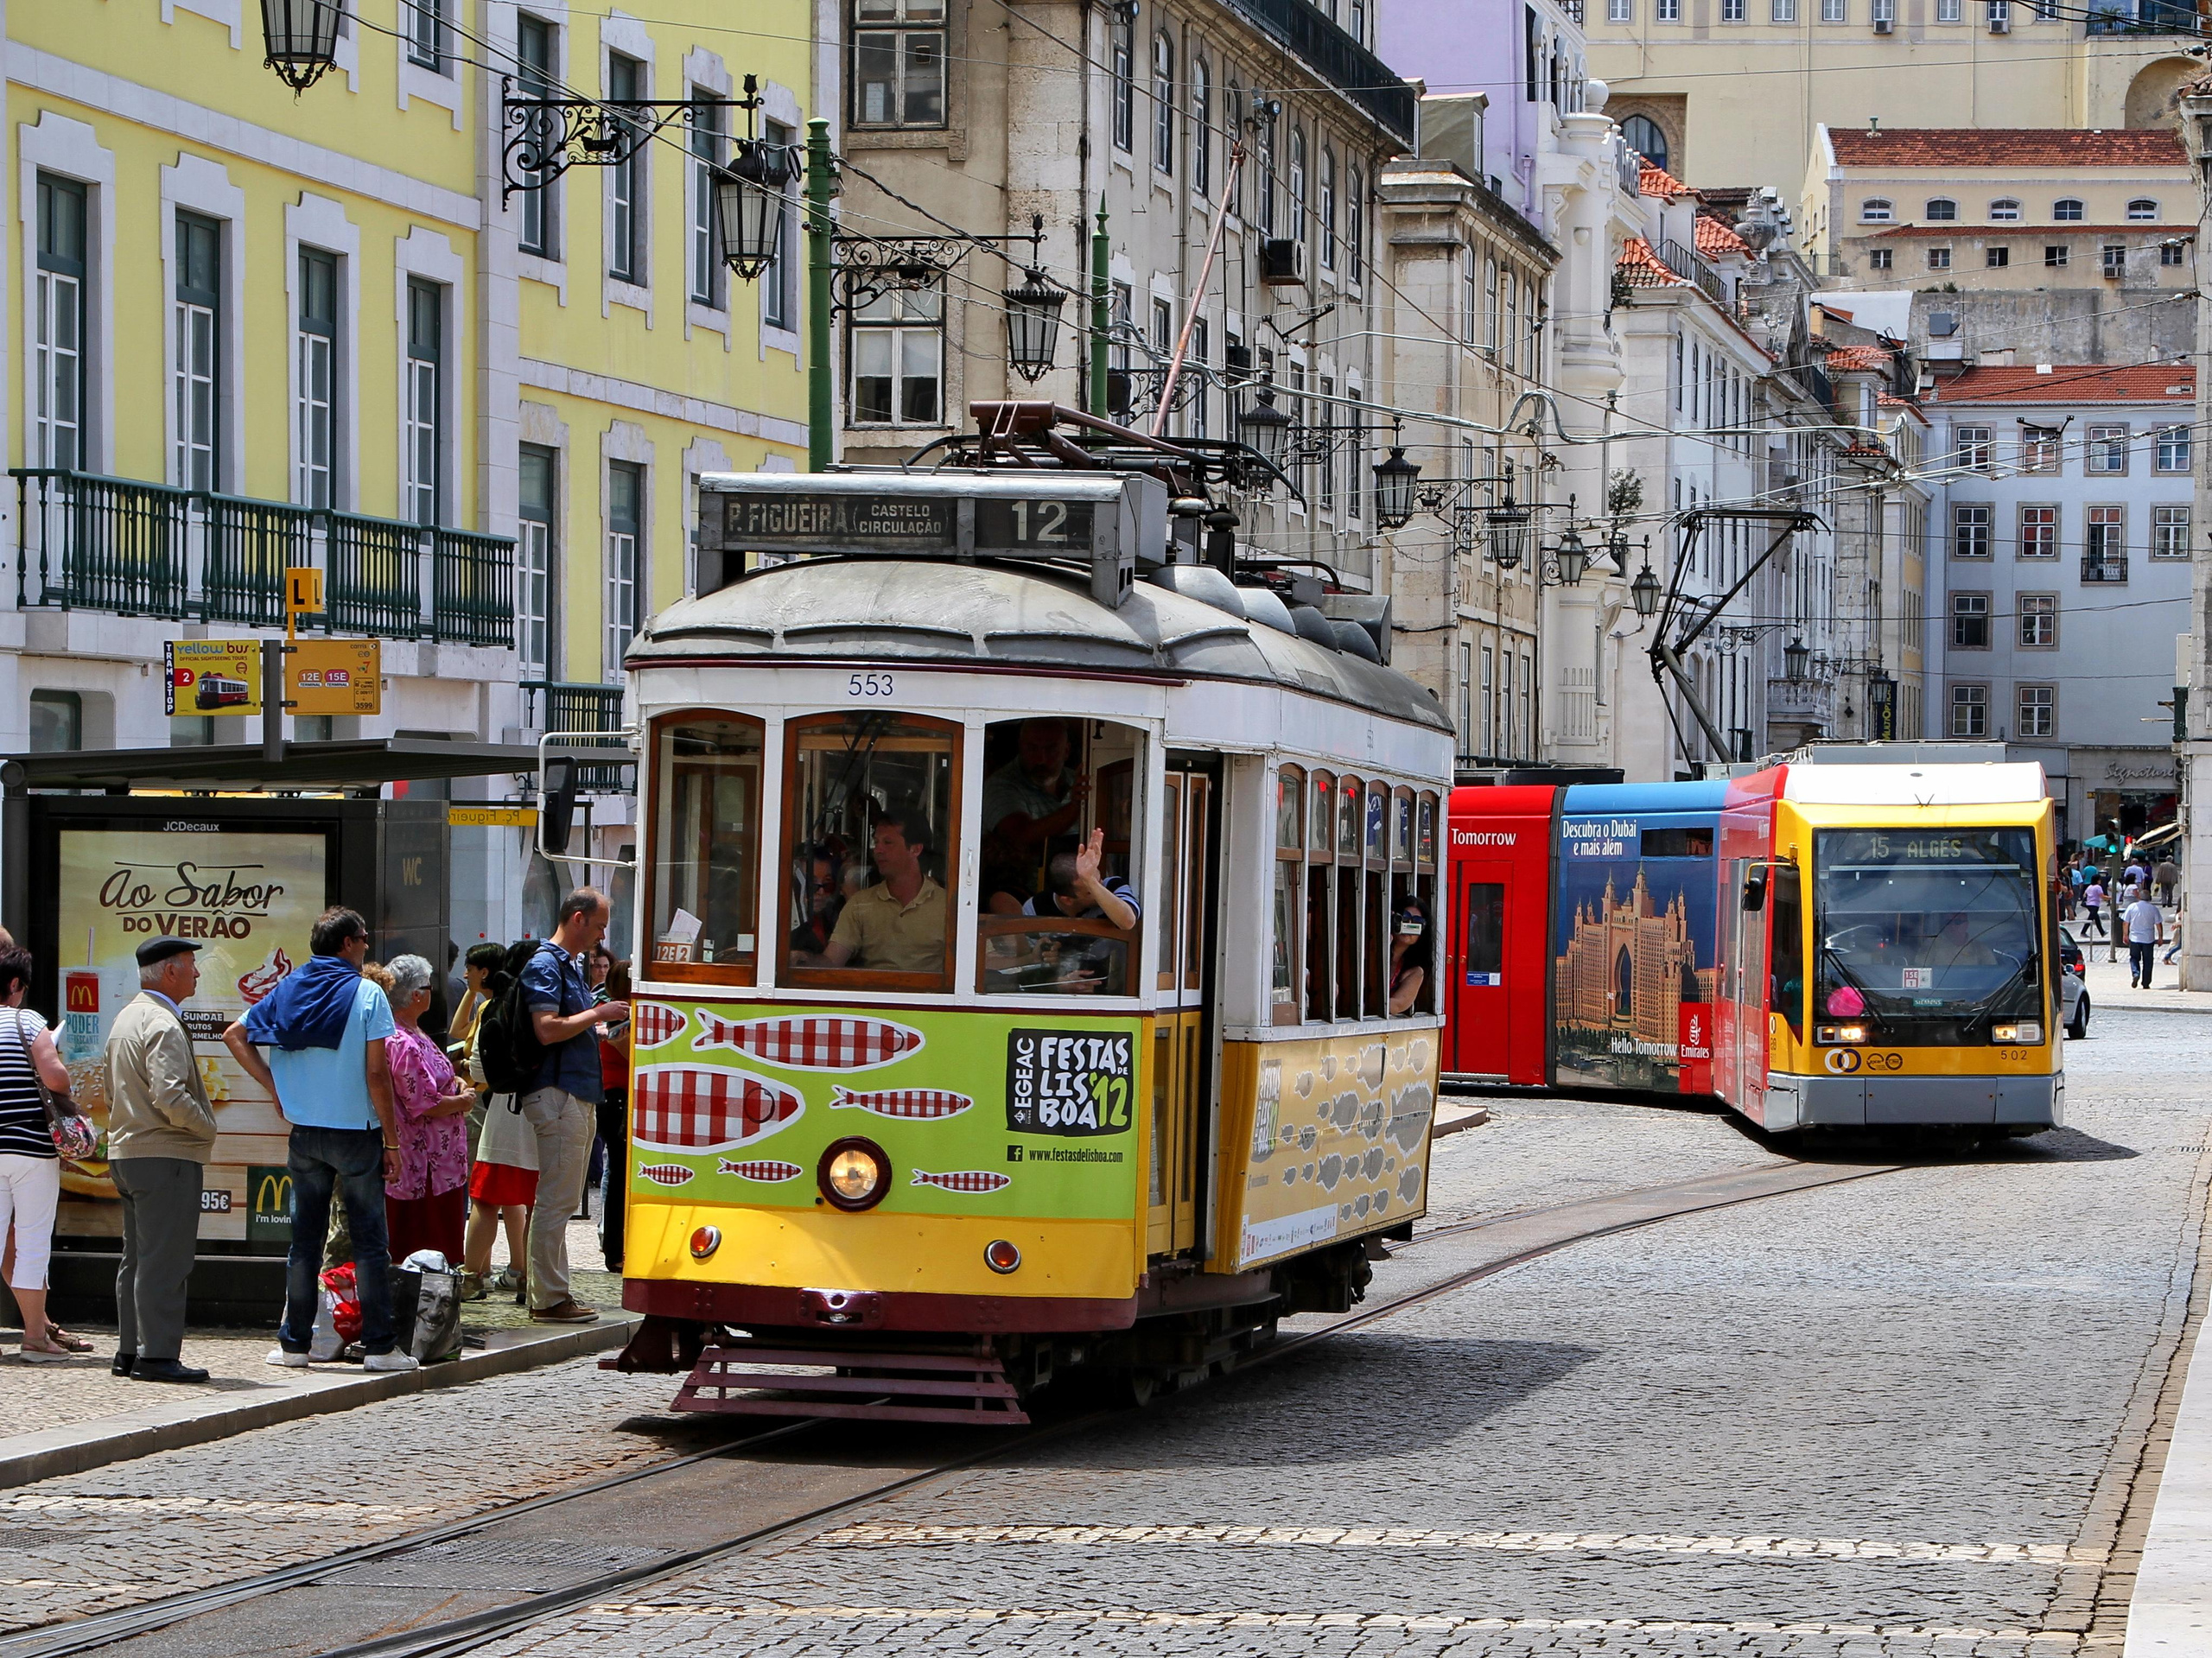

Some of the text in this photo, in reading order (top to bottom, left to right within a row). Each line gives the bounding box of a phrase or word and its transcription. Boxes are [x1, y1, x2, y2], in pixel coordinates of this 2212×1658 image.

[748, 500, 848, 532] FIGUEIRA
[871, 505, 930, 517] CASTELO
[859, 519, 942, 536] CIRCULAÇÃO
[1011, 500, 1067, 542] 12
[293, 579, 305, 605] L
[177, 641, 249, 654] yellow bus
[182, 672, 190, 683] 2
[302, 672, 320, 681] 12E
[328, 672, 346, 681] 15E
[849, 674, 893, 696] 553
[2104, 760, 2175, 785] Signature
[162, 821, 219, 832] JCDecaux
[1562, 819, 1637, 838] Descubra o Dubai
[1451, 828, 1516, 846] Tomorrow
[1573, 838, 1623, 856] e mais além
[1870, 835, 1961, 859] 15 ALGÉS
[403, 857, 422, 886] WC
[99, 861, 284, 909] Ao Sabor
[123, 909, 251, 939] DO VERÃO
[657, 945, 675, 961] 12E
[67, 1013, 99, 1034] PODER
[183, 1012, 223, 1021] SUNDAE
[1040, 1037, 1128, 1075] FESTAS DE
[1611, 1037, 1677, 1056] Hello Tomorrow
[1681, 1044, 1710, 1058] Emirates
[2000, 1050, 2027, 1060] 502
[1014, 1038, 1034, 1108] EGEAC
[1039, 1070, 1089, 1105] LIS
[1039, 1098, 1097, 1129] BOA
[1029, 1147, 1123, 1163] www.festasdelisboa.com
[256, 1214, 269, 1223] i'm
